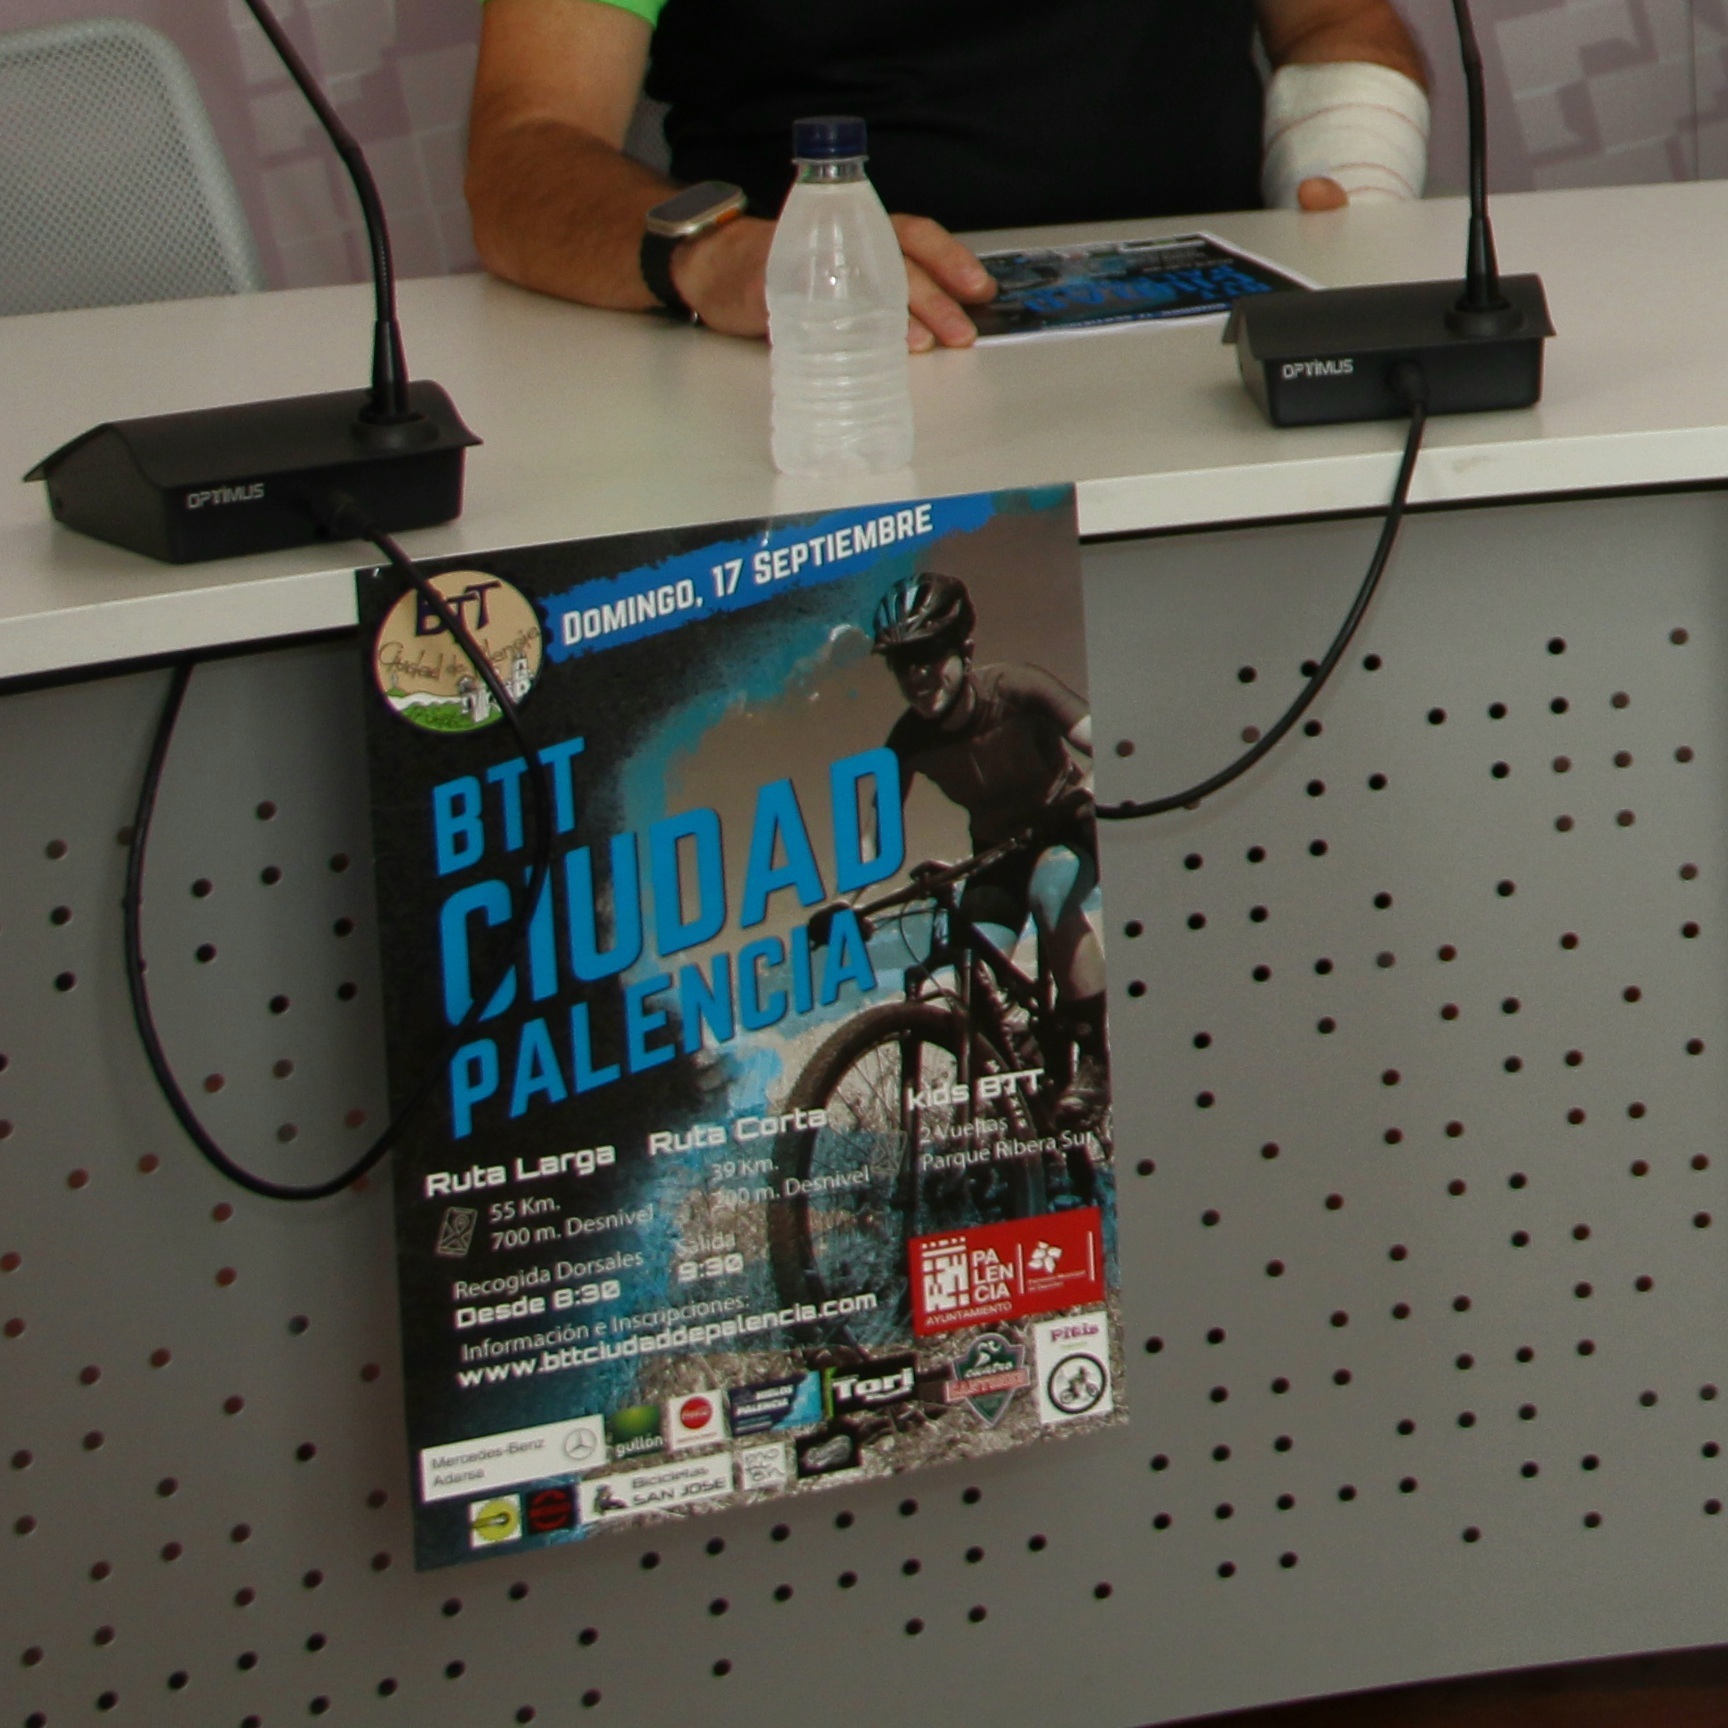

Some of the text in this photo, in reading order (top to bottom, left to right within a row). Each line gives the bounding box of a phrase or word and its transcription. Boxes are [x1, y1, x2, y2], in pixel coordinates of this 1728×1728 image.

[1283, 358, 1354, 379] OPTIMUS
[188, 483, 265, 508] OPTIMUS
[563, 505, 933, 646] DOMINGO, 17 SEPTIEMBRE
[432, 736, 585, 876] BTT
[439, 746, 905, 1027] CIUDAD
[450, 906, 877, 1139] PALENCIA
[906, 1068, 1043, 1111] kids BTT
[649, 1108, 828, 1156] Ruta Corta
[922, 1135, 1057, 1172] Parque Ribera
[425, 1145, 616, 1198] Ruta Larga
[566, 1205, 653, 1236] Desnivel
[454, 1250, 643, 1301] Recogida Dorsales
[972, 1249, 999, 1266] PA
[974, 1264, 1014, 1283] LEN
[456, 1280, 620, 1329] Desde 8:30
[974, 1284, 1011, 1303] CIA
[456, 1293, 878, 1388] www.bttciudaddepalencia.com
[461, 1321, 588, 1361] Información
